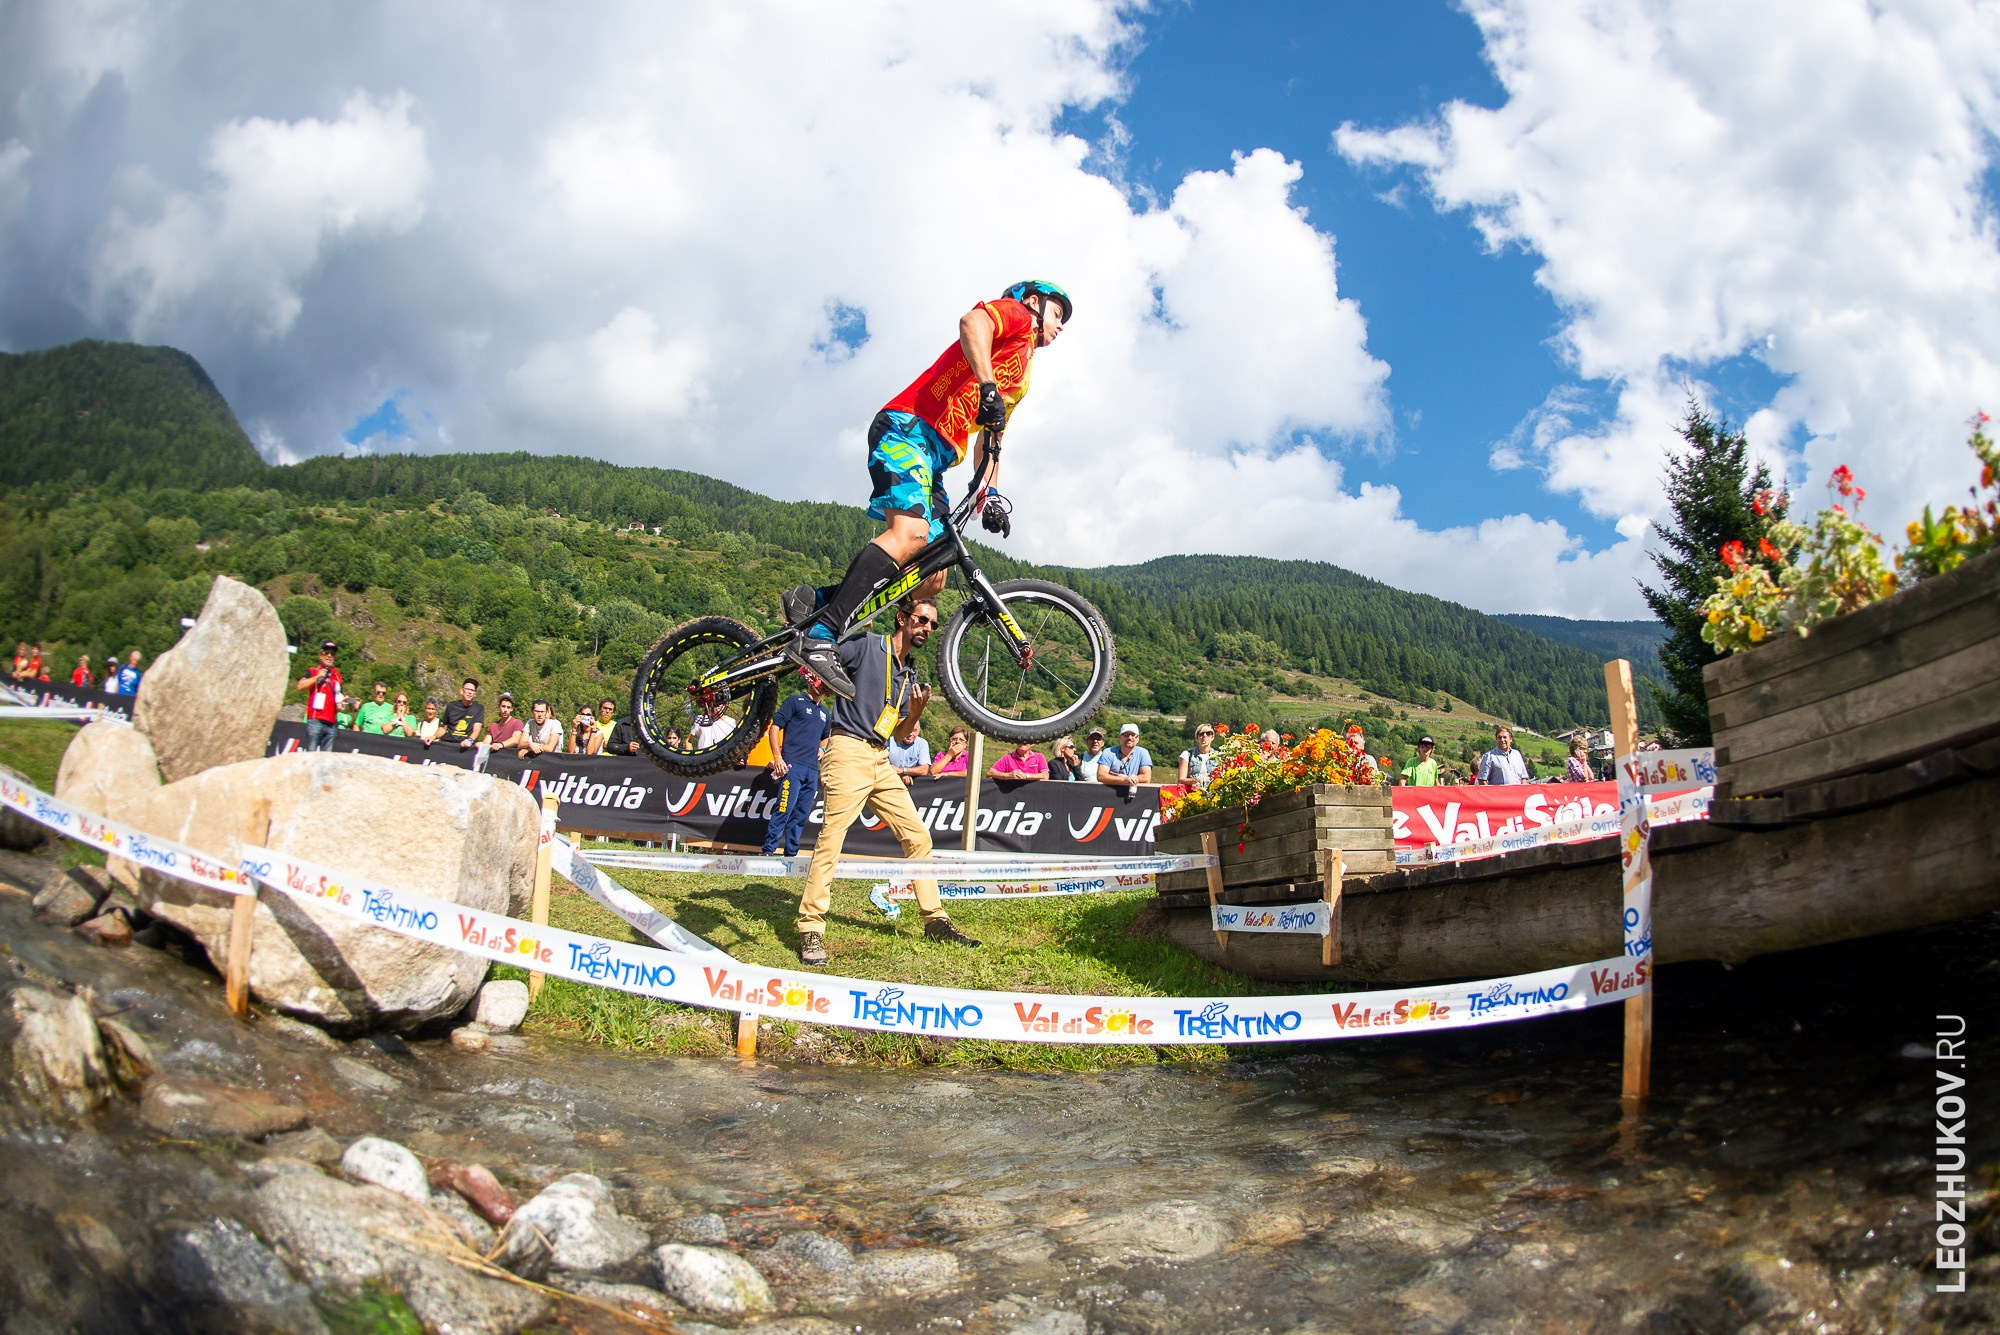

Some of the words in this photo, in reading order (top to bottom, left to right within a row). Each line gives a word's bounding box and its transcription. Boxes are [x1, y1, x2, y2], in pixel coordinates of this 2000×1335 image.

[540, 772, 644, 811] vittoria
[1416, 801, 1491, 846] Val
[1496, 814, 1526, 836] di
[1524, 793, 1616, 830] Sole
[938, 882, 986, 898] TRENTINO
[1055, 879, 1105, 893] TRENTINO
[1115, 875, 1133, 887] Val
[286, 863, 305, 892] Val
[316, 875, 352, 907] Sole
[361, 889, 439, 931] TRENTINO
[458, 914, 487, 947] Val
[488, 936, 503, 950] di
[503, 928, 554, 964] Sole
[568, 942, 676, 988] TRENTINO
[703, 966, 742, 1003] Val
[745, 987, 765, 1005] di
[766, 978, 831, 1014] Sole
[849, 989, 984, 1030] TRENTINO
[1013, 1001, 1059, 1033] Val
[1063, 1016, 1082, 1035] di
[1084, 1006, 1155, 1036] Sole
[1173, 1008, 1302, 1040] TRENTINO
[1331, 1001, 1371, 1031] Val
[1373, 1011, 1391, 1027] di
[1393, 998, 1451, 1026] Sole
[1467, 983, 1569, 1018] TRENTINO
[1590, 967, 1619, 997] Val
[1621, 971, 1635, 989] di
